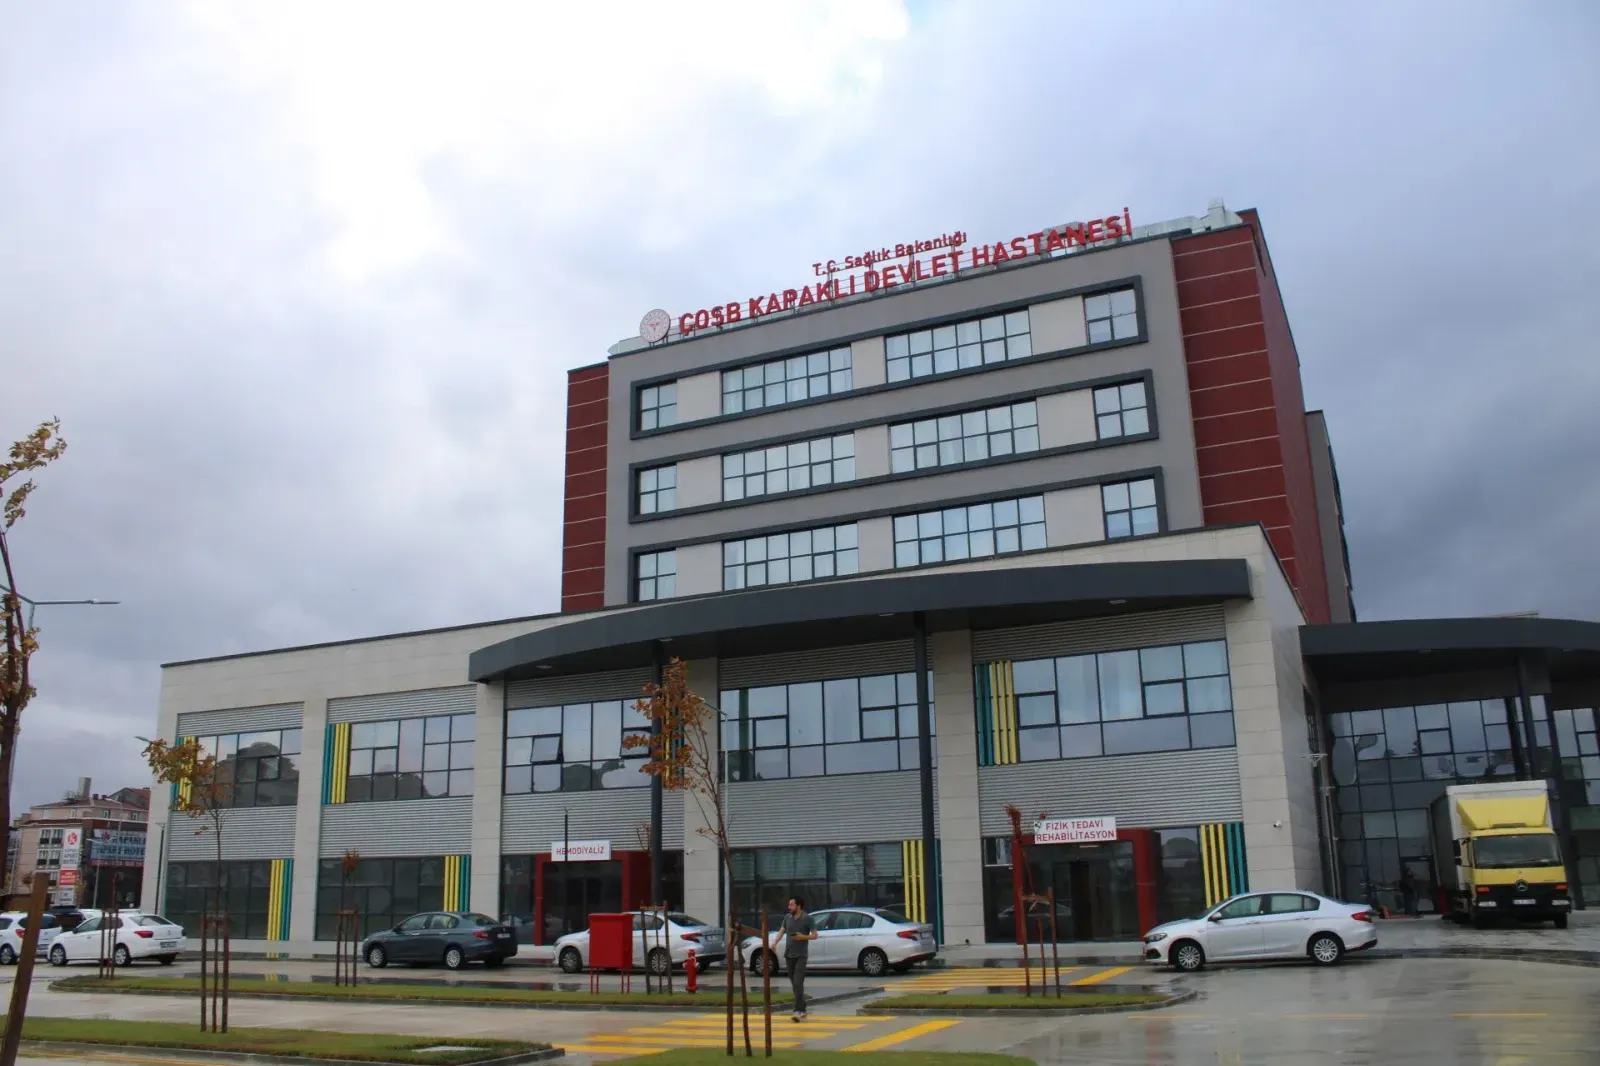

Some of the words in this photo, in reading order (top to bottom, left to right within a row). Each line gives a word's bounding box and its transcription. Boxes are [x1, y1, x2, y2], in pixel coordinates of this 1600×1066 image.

[812, 259, 841, 276] T.C.
[845, 247, 891, 267] Sağlık
[895, 230, 967, 258] Bakanlığı
[679, 302, 741, 336] ÇOSB
[749, 274, 855, 319] KAPAKLI
[864, 250, 963, 293] DEVLET
[972, 207, 1133, 269] HASTANESİ
[1071, 819, 1103, 829] TEDAVİ
[1037, 830, 1114, 841] REHABİLİTASYON
[556, 845, 604, 855] HEMODİYALİZ
